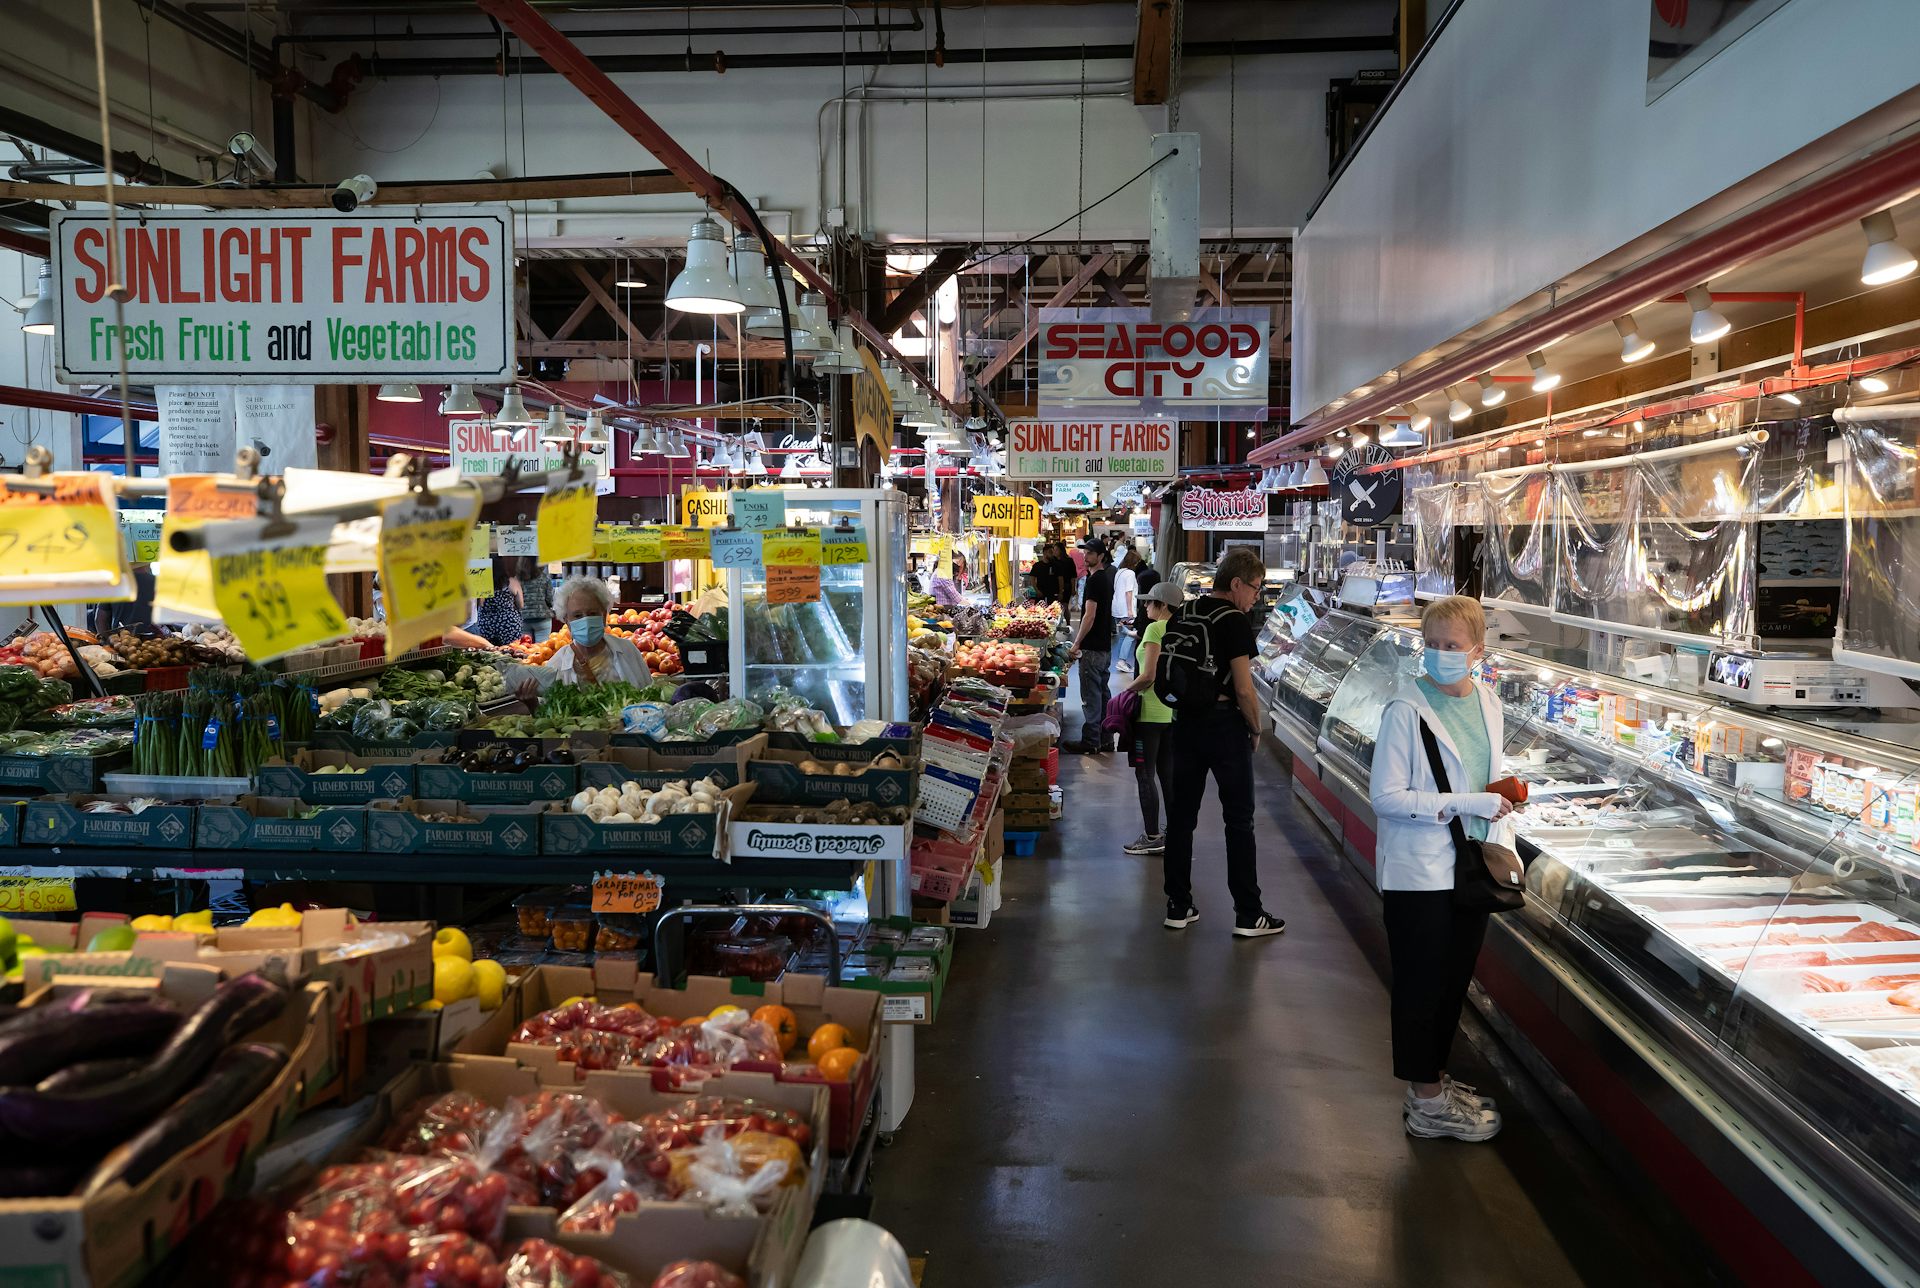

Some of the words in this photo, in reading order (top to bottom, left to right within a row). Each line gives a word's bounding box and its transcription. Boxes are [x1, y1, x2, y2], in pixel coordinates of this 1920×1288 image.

[74, 227, 311, 303] SUNLIGHT
[332, 226, 490, 303] FARMS
[90, 317, 164, 361] Fresh
[178, 317, 251, 361] Fruit
[267, 320, 312, 360] and
[326, 317, 476, 361] Vegetables
[1046, 324, 1261, 359] SEAFOOD
[1104, 361, 1205, 396] CITY
[245, 403, 296, 411] SURVEILLANCE
[1014, 424, 1103, 452] SUNLIGHT
[1110, 423, 1171, 452] FARMS
[462, 457, 489, 473] Fresh
[523, 457, 540, 472] and
[1019, 456, 1047, 473] Fresh
[1052, 456, 1080, 473] Fruit
[1085, 458, 1103, 473] and
[1108, 457, 1164, 473] Vegetables
[744, 503, 769, 511] ENOKI
[982, 503, 1034, 520] CASHER
[350, 780, 375, 794] FRESH
[509, 780, 534, 793] FRESH
[843, 780, 869, 797] FRESH
[123, 821, 150, 836] FRESH
[294, 824, 322, 840] FRESH
[643, 830, 672, 844] FRESH
[466, 830, 493, 845] FRESH
[748, 829, 813, 852] Beauty
[815, 833, 885, 854] Merced
